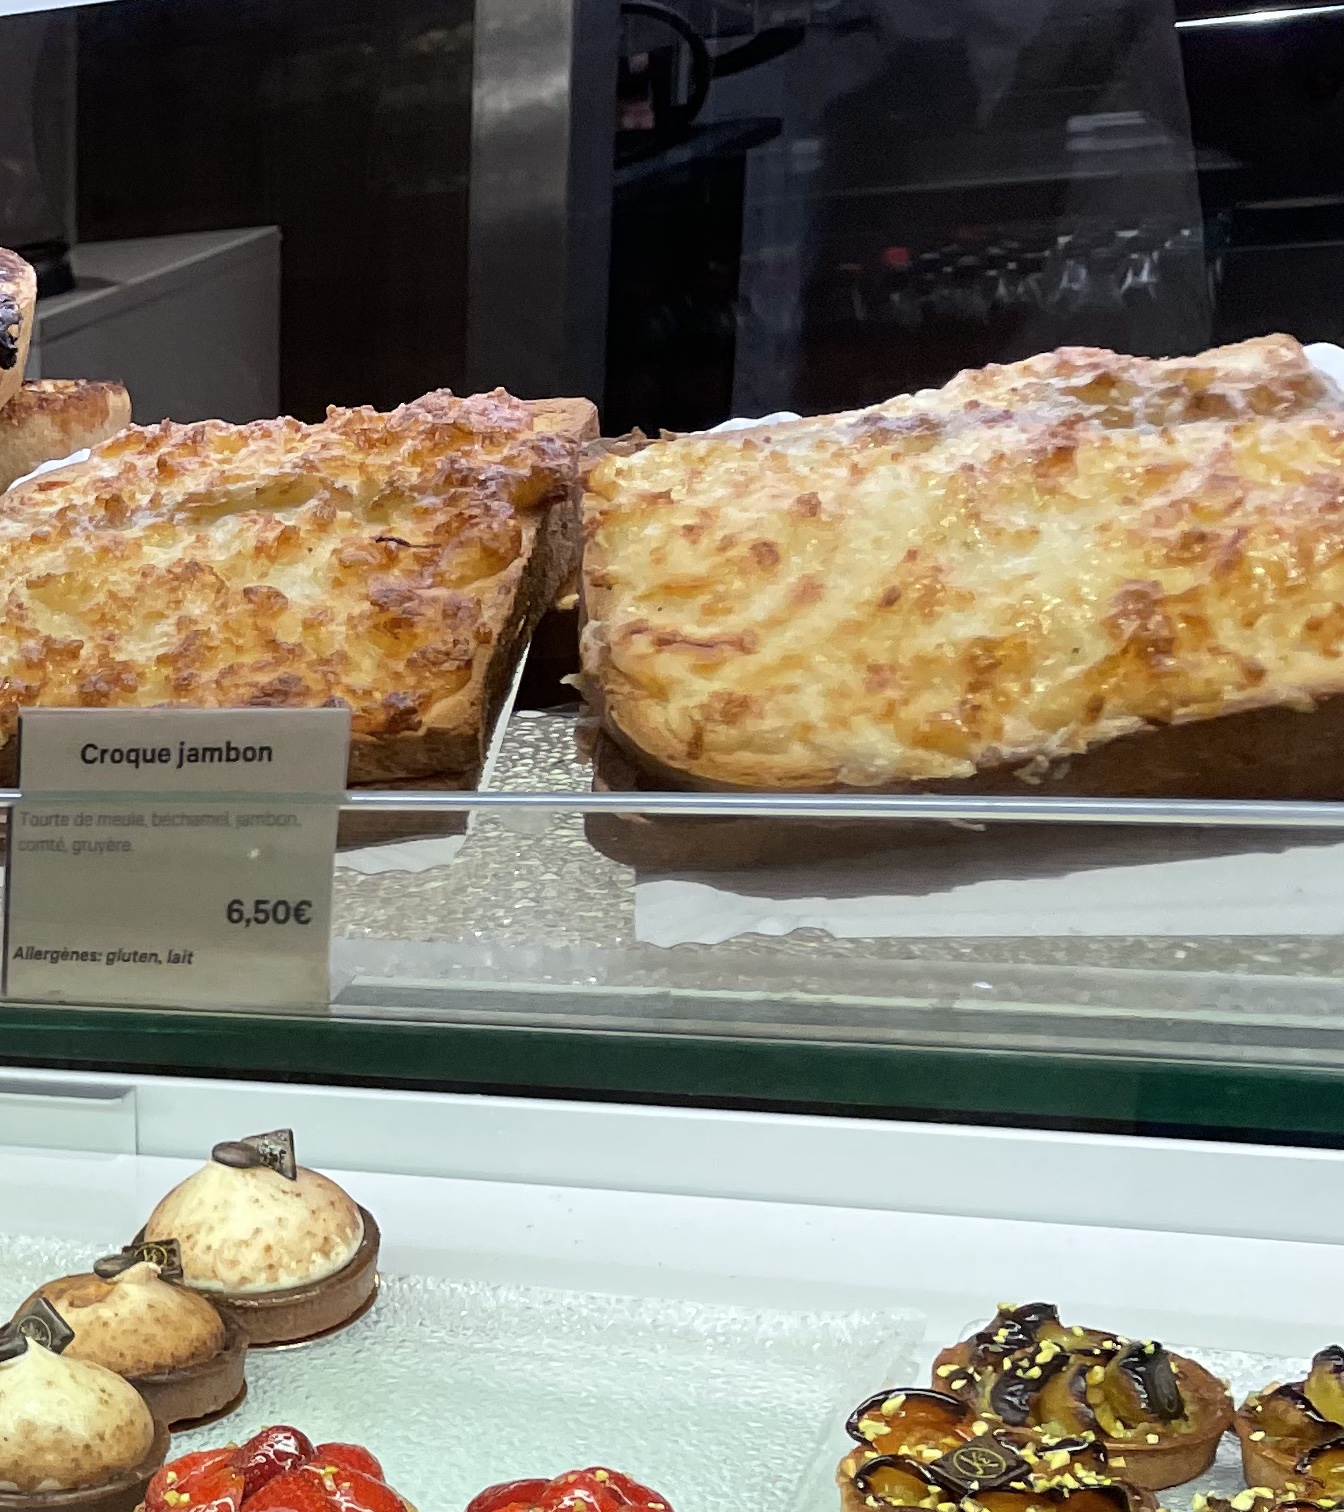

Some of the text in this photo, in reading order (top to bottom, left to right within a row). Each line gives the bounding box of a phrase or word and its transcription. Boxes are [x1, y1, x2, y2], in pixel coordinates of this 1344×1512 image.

[80, 741, 274, 769] Croque jambon
[19, 811, 69, 827] Tourte
[74, 812, 93, 827] de
[226, 899, 313, 928] 6,50€
[166, 949, 195, 965] lait
